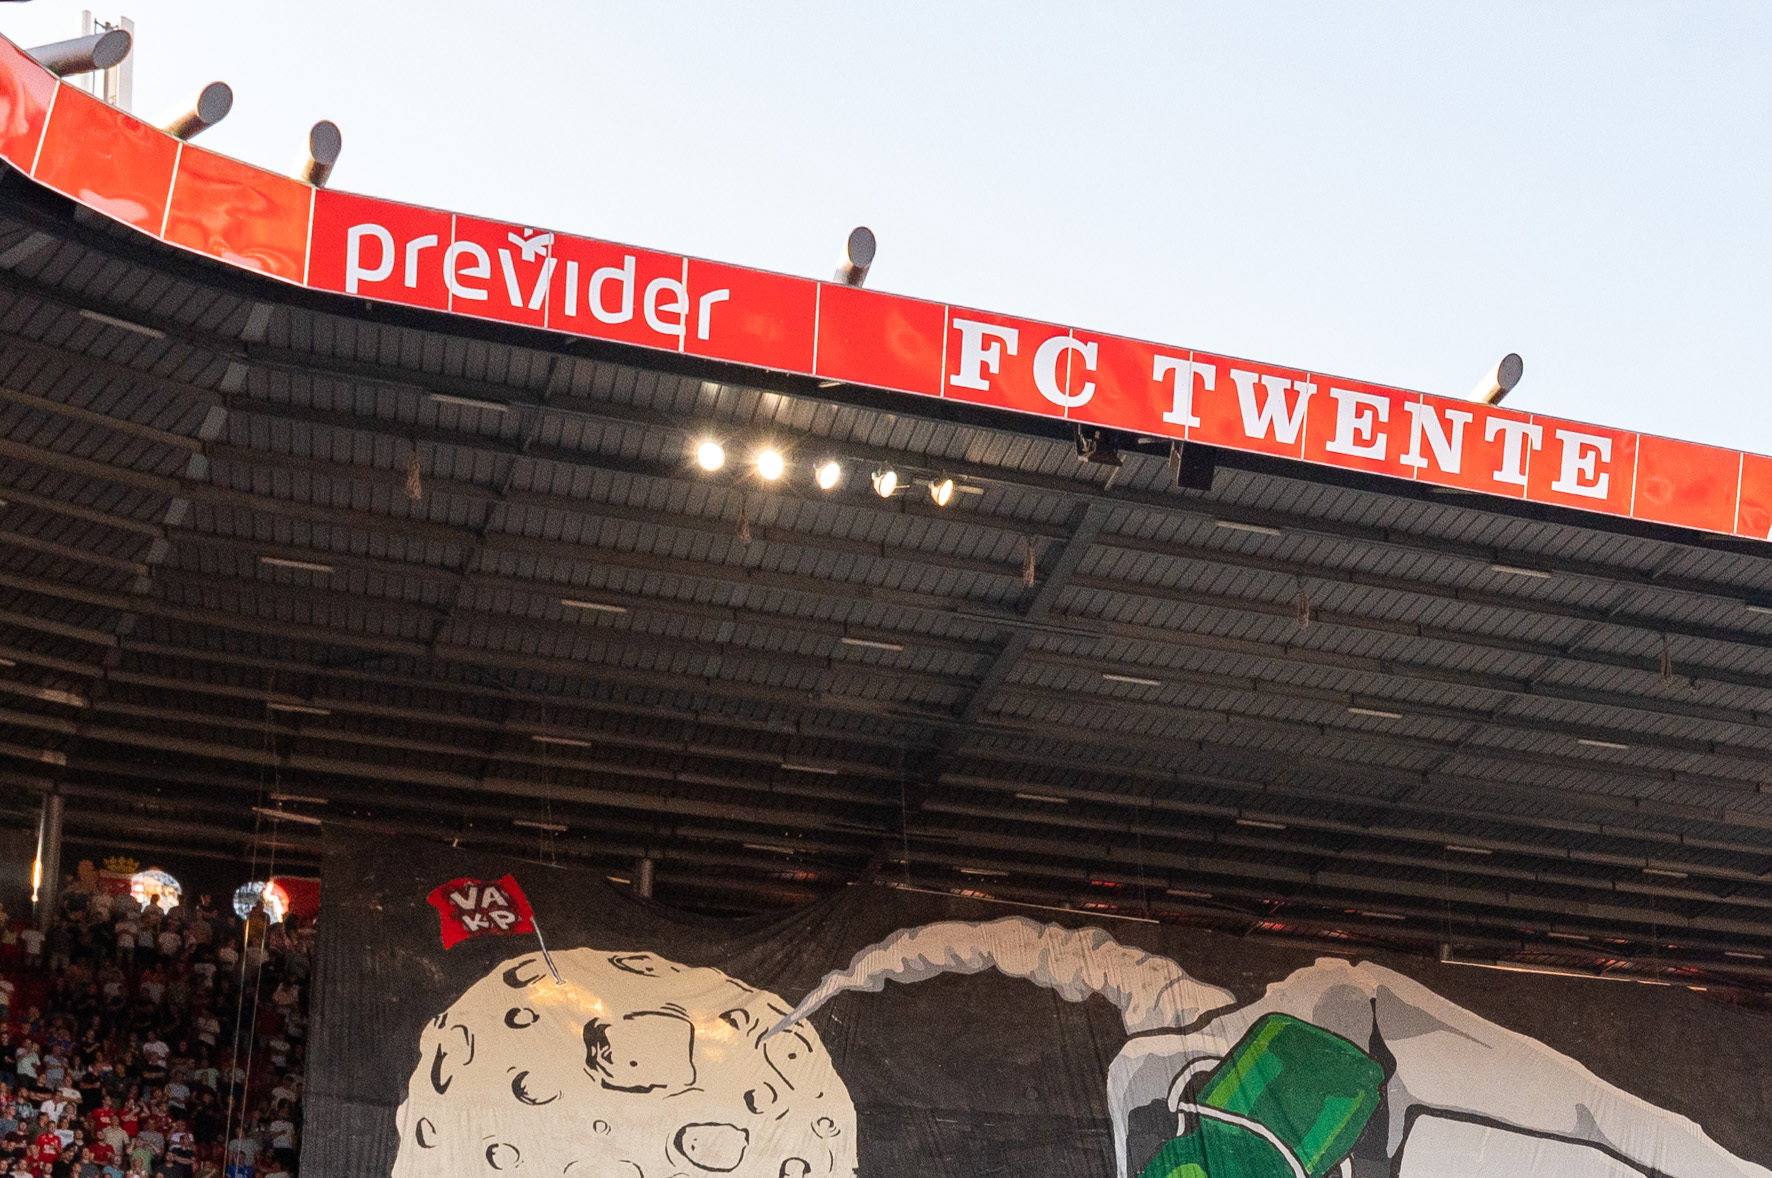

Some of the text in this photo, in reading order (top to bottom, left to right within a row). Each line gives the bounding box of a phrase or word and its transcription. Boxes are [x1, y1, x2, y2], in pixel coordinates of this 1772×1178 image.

[345, 223, 730, 340] previder
[949, 317, 1612, 500] FC TWENTE
[450, 886, 509, 910] VA
[461, 910, 516, 932] KP
